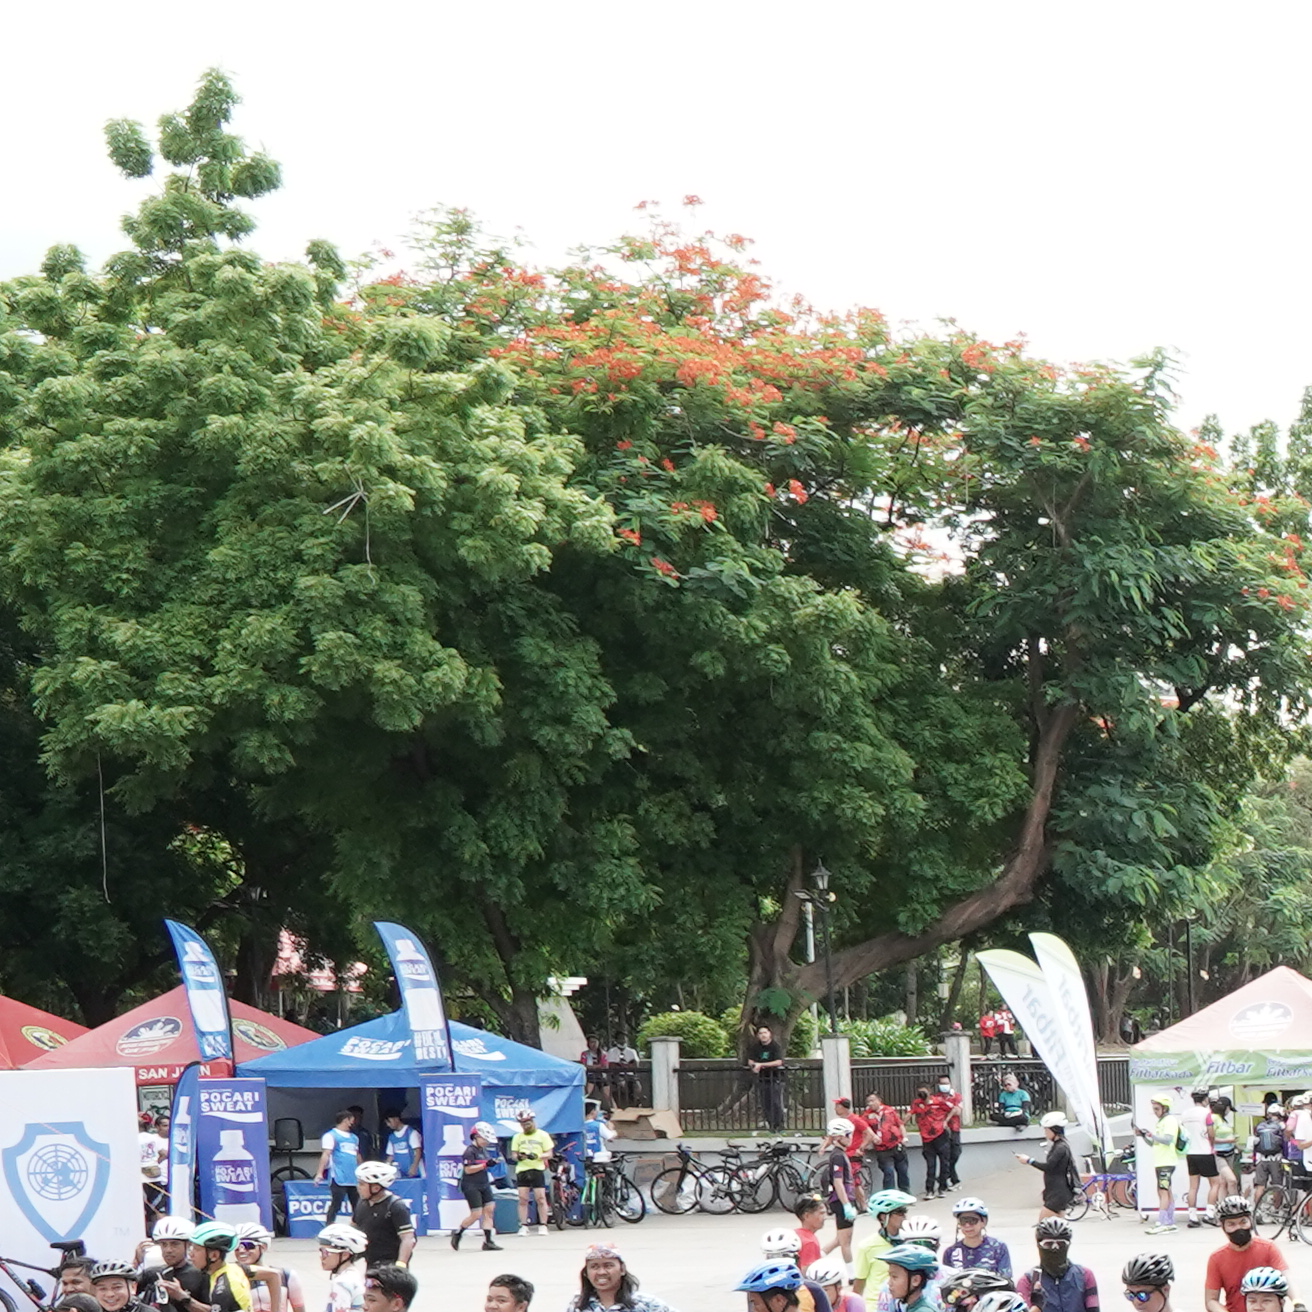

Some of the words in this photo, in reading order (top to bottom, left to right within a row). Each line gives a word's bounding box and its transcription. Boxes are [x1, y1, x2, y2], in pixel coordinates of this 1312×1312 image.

[138, 1068, 168, 1080] SAN
[172, 1065, 211, 1079] JN
[1206, 1061, 1255, 1074] Fitbar
[201, 1091, 260, 1102] POCARI
[426, 1086, 476, 1097] POCARI
[201, 1101, 254, 1112] SWEAT
[426, 1097, 472, 1107] SWEAT
